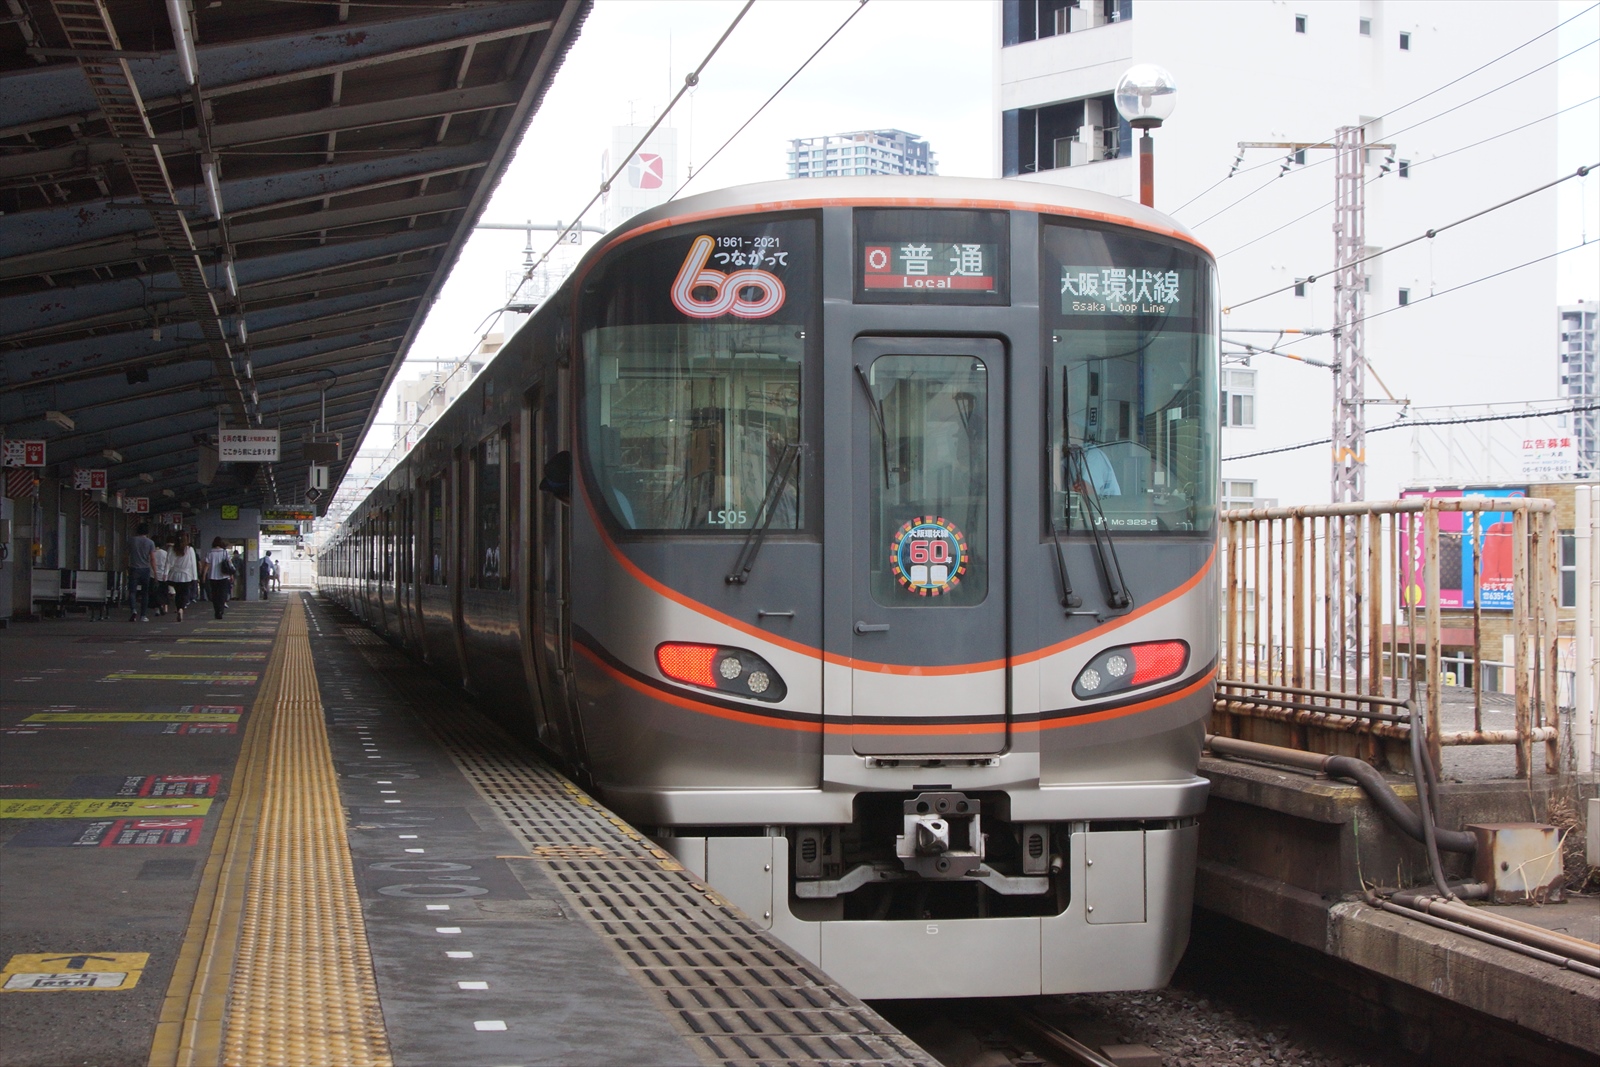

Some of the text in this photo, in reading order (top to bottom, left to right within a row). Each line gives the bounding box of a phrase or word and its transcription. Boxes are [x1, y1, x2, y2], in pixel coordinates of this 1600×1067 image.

[570, 232, 578, 244] 2
[714, 249, 789, 266] つながって
[899, 242, 984, 277] 普通
[670, 234, 786, 319] 60
[903, 276, 951, 289] Local
[1060, 268, 1180, 304] 大阪環状線
[1110, 303, 1138, 314] Loop
[1142, 303, 1166, 313] Line
[1522, 437, 1571, 450] 広告募集
[707, 510, 747, 524] LS05
[909, 540, 949, 564] 60
[926, 924, 939, 935] 5
